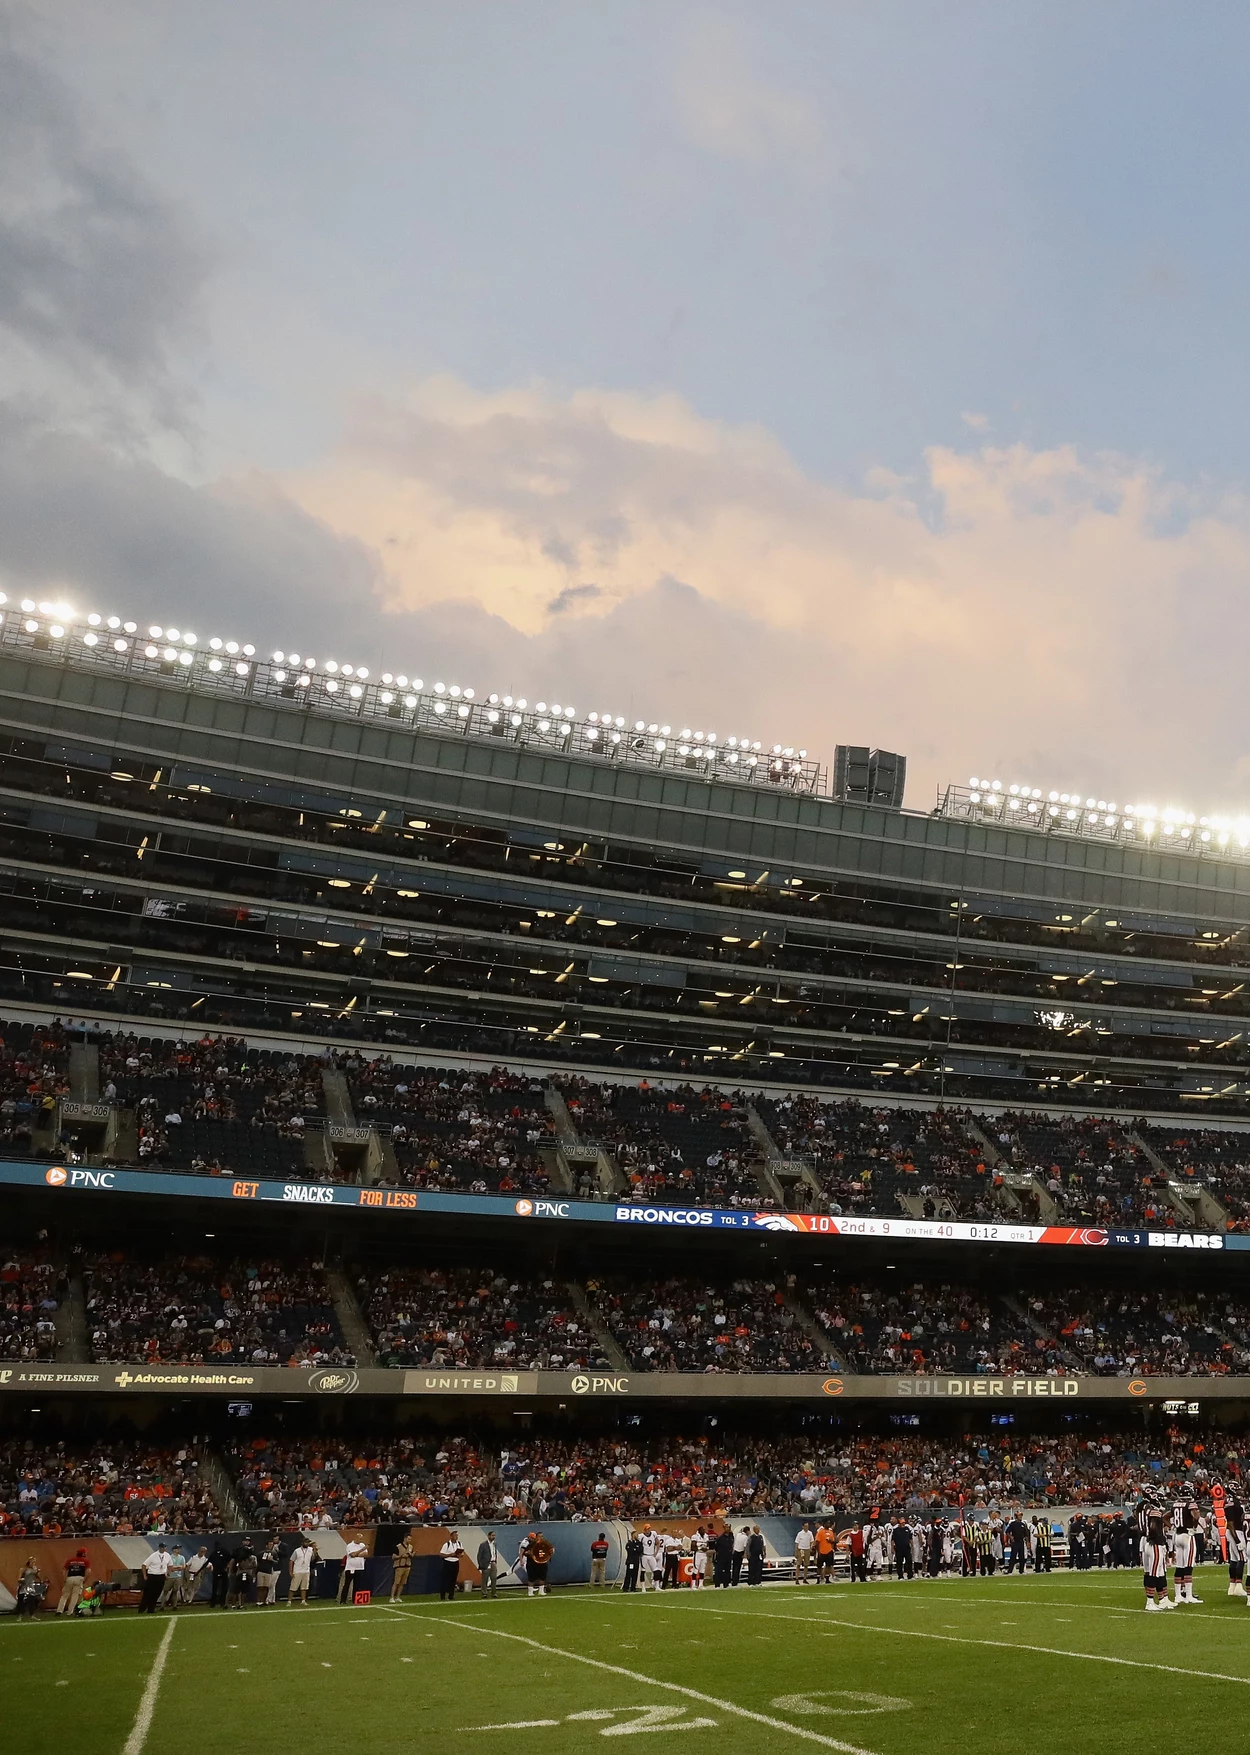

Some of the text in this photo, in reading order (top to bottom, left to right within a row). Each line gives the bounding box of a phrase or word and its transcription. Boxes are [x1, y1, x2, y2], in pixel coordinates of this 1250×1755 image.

[64, 1104, 79, 1113] 305
[93, 1106, 108, 1116] 306
[356, 1130, 368, 1138] 307
[70, 1170, 116, 1188] PNC
[232, 1181, 418, 1209] GET SNACKS FOR LESS
[535, 1201, 570, 1218] PNC
[616, 1206, 750, 1227] BRONCOS TOL 3
[809, 1216, 830, 1232] 10
[840, 1220, 866, 1233] 2nd
[882, 1222, 890, 1234] 9
[905, 1227, 917, 1235] ON
[918, 1228, 934, 1236] THE
[937, 1225, 953, 1237] 40
[970, 1226, 998, 1239] 0:12
[1010, 1232, 1026, 1240] QTR
[1116, 1232, 1224, 1250] TOL 3 BEARS
[28, 1374, 54, 1382] FINE
[55, 1374, 100, 1382] PILSNER
[134, 1374, 254, 1386] Advocate Health Care
[320, 1376, 346, 1390] Pepper
[425, 1378, 496, 1388] UNITED
[592, 1377, 630, 1393] PNC
[898, 1380, 1079, 1396] SOLDIER FIELD
[870, 1507, 880, 1518] 2
[1174, 1508, 1184, 1528] 81
[356, 1592, 370, 1604] 20
